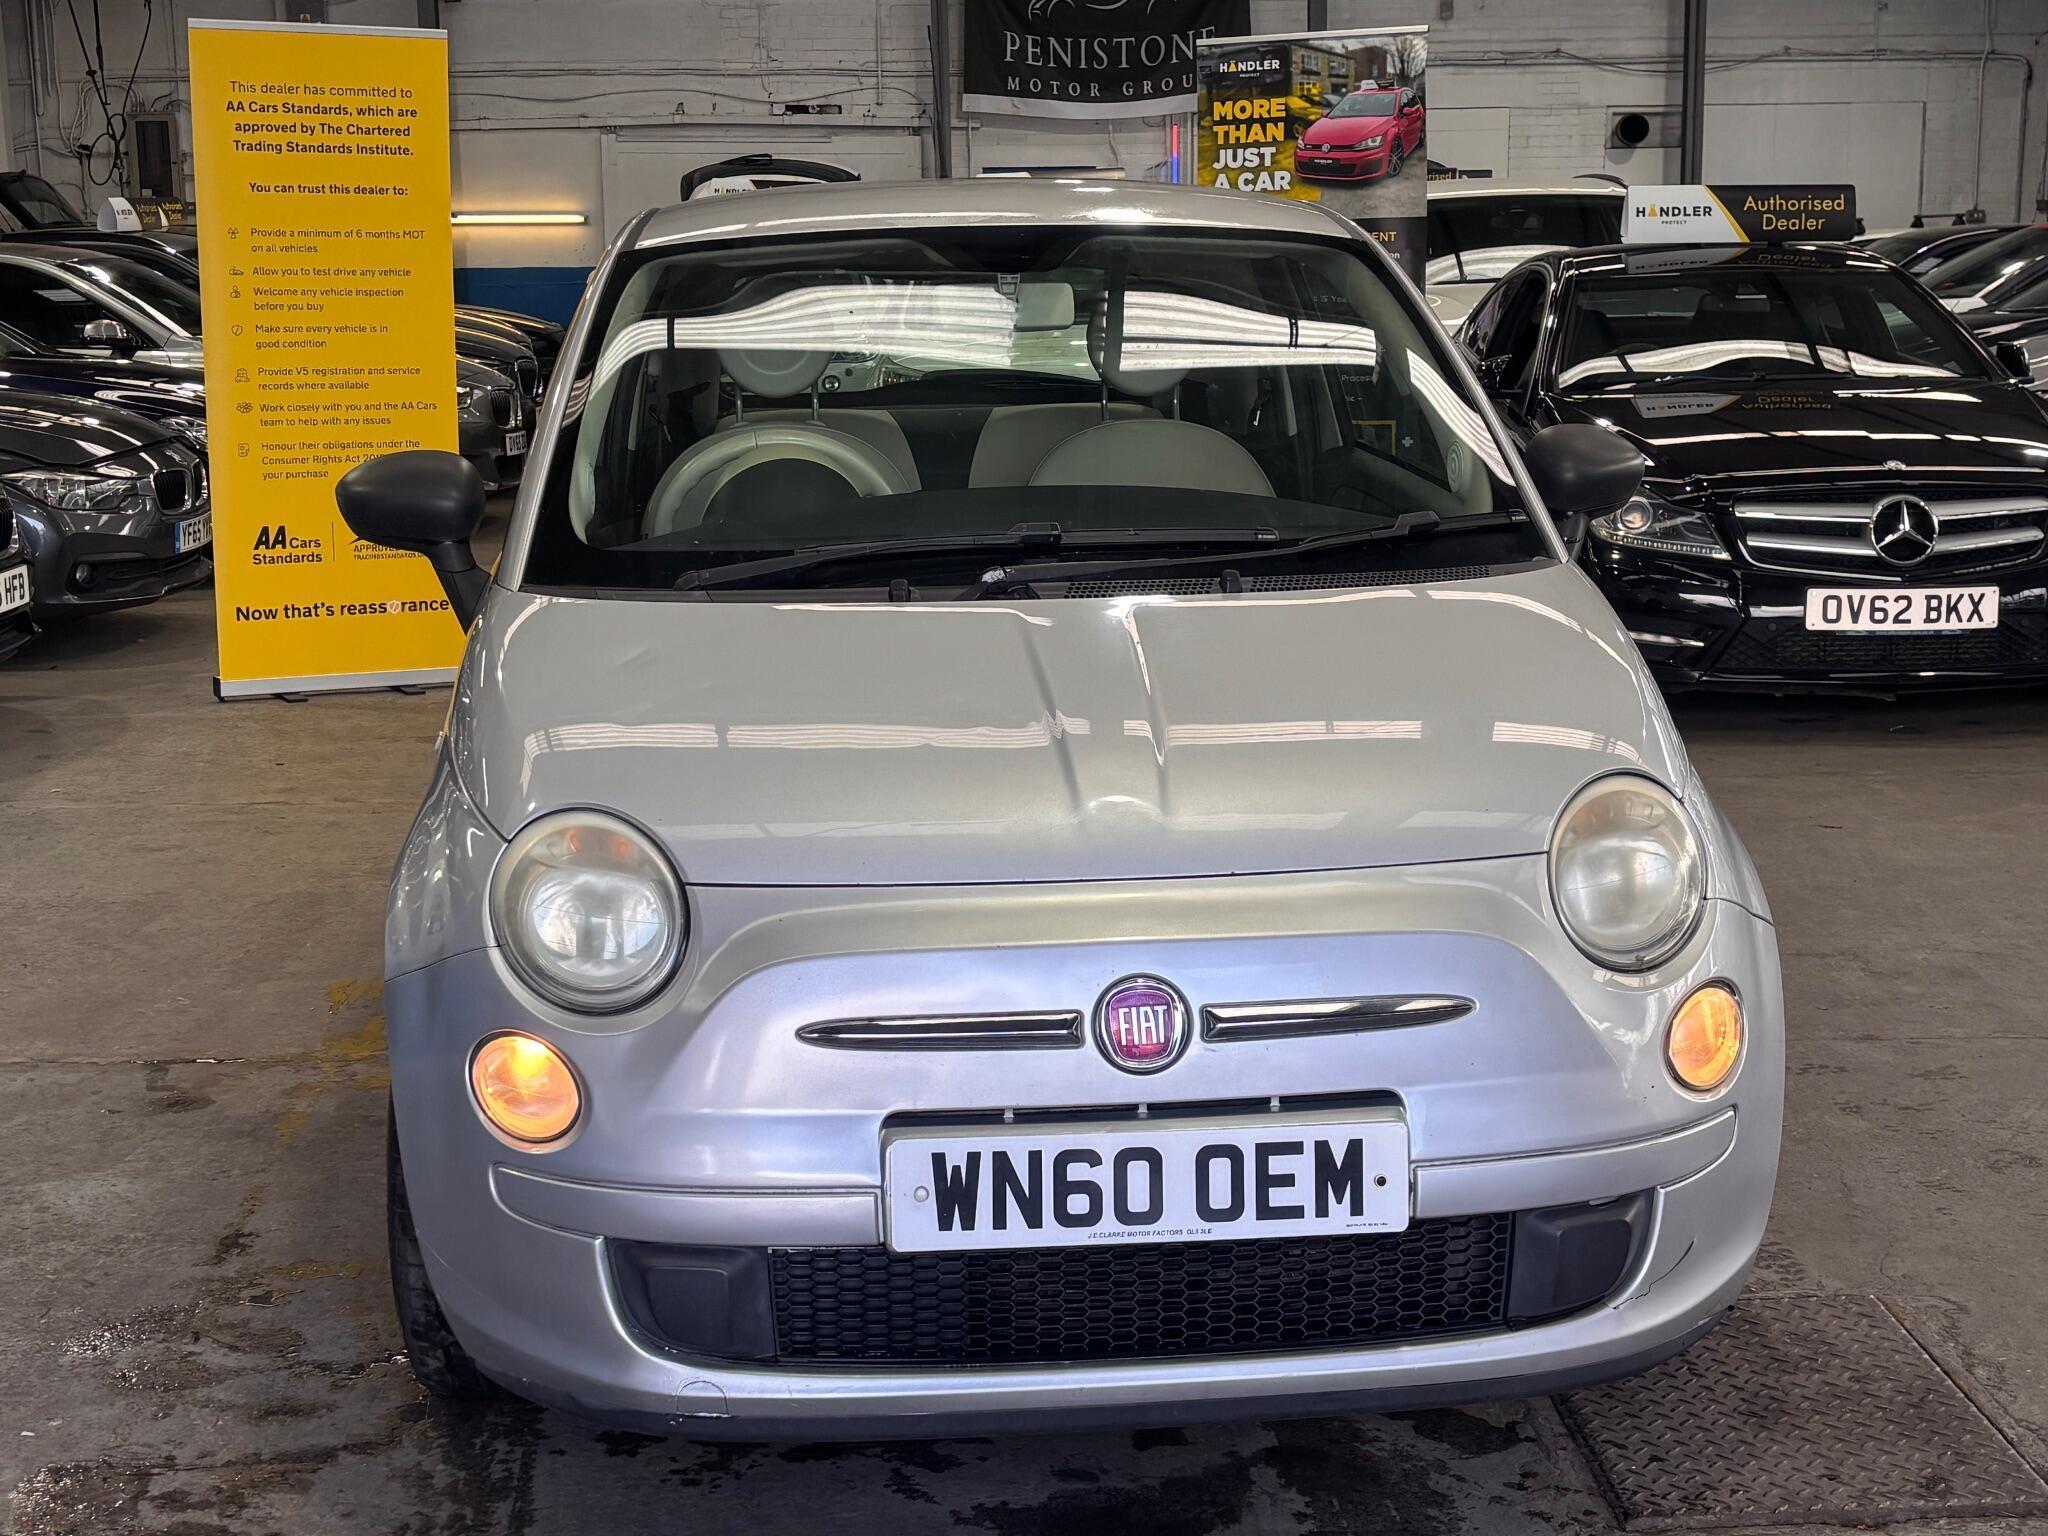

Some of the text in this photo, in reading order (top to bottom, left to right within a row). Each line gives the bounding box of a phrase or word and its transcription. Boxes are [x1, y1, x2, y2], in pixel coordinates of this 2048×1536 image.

[229, 81, 412, 98] This dealer has committed to
[1007, 76, 1101, 97] MOTOR
[226, 101, 417, 118] AA Cars Standards, which are
[1213, 98, 1286, 121] MORE
[235, 122, 410, 136] approved by The Chartered
[1213, 122, 1285, 145] THAN
[233, 140, 413, 155] Trading Standards Institute.
[1212, 147, 1276, 170] JUST
[249, 182, 408, 195] You can trust this dealer to:
[1214, 171, 1291, 192] A CAR
[1743, 194, 1845, 212] Authorised
[1762, 214, 1826, 231] Dealer
[250, 229, 287, 238] Provide
[298, 229, 342, 238] minimum
[344, 230, 354, 238] of
[356, 230, 363, 239] 6
[364, 230, 401, 239] months
[402, 230, 426, 239] MOT
[251, 244, 318, 253] on all vehicles
[252, 267, 412, 278] Allow you to test drive any vehicle
[253, 288, 404, 299] Welcome any vehicle inspection
[254, 302, 325, 313] before you buy
[254, 325, 281, 333] Make
[306, 326, 332, 335] every
[334, 324, 368, 333] vehicle
[370, 324, 378, 333] is
[379, 324, 388, 333] in
[256, 340, 327, 350] good condition
[258, 366, 421, 377] Provide V5 registration and service
[258, 381, 370, 390] records where available
[259, 402, 438, 413] Work closely with you and the AA Cars
[260, 417, 392, 428] team to help with any issues
[261, 440, 420, 451] Honour their obligations under the
[262, 456, 311, 465] Consumer
[312, 455, 342, 466] Rights
[345, 455, 361, 463] Act
[262, 470, 329, 481] your purchase
[182, 520, 201, 546] YF65
[253, 525, 321, 550] AA Cars
[253, 552, 322, 565] Standards
[4, 573, 25, 605] HFB
[236, 606, 278, 621] Now
[284, 602, 335, 619] that's
[1822, 593, 1985, 624] OV62 BKX
[1118, 1005, 1168, 1046] FIAT
[931, 1138, 1364, 1232] WN60 OEM
